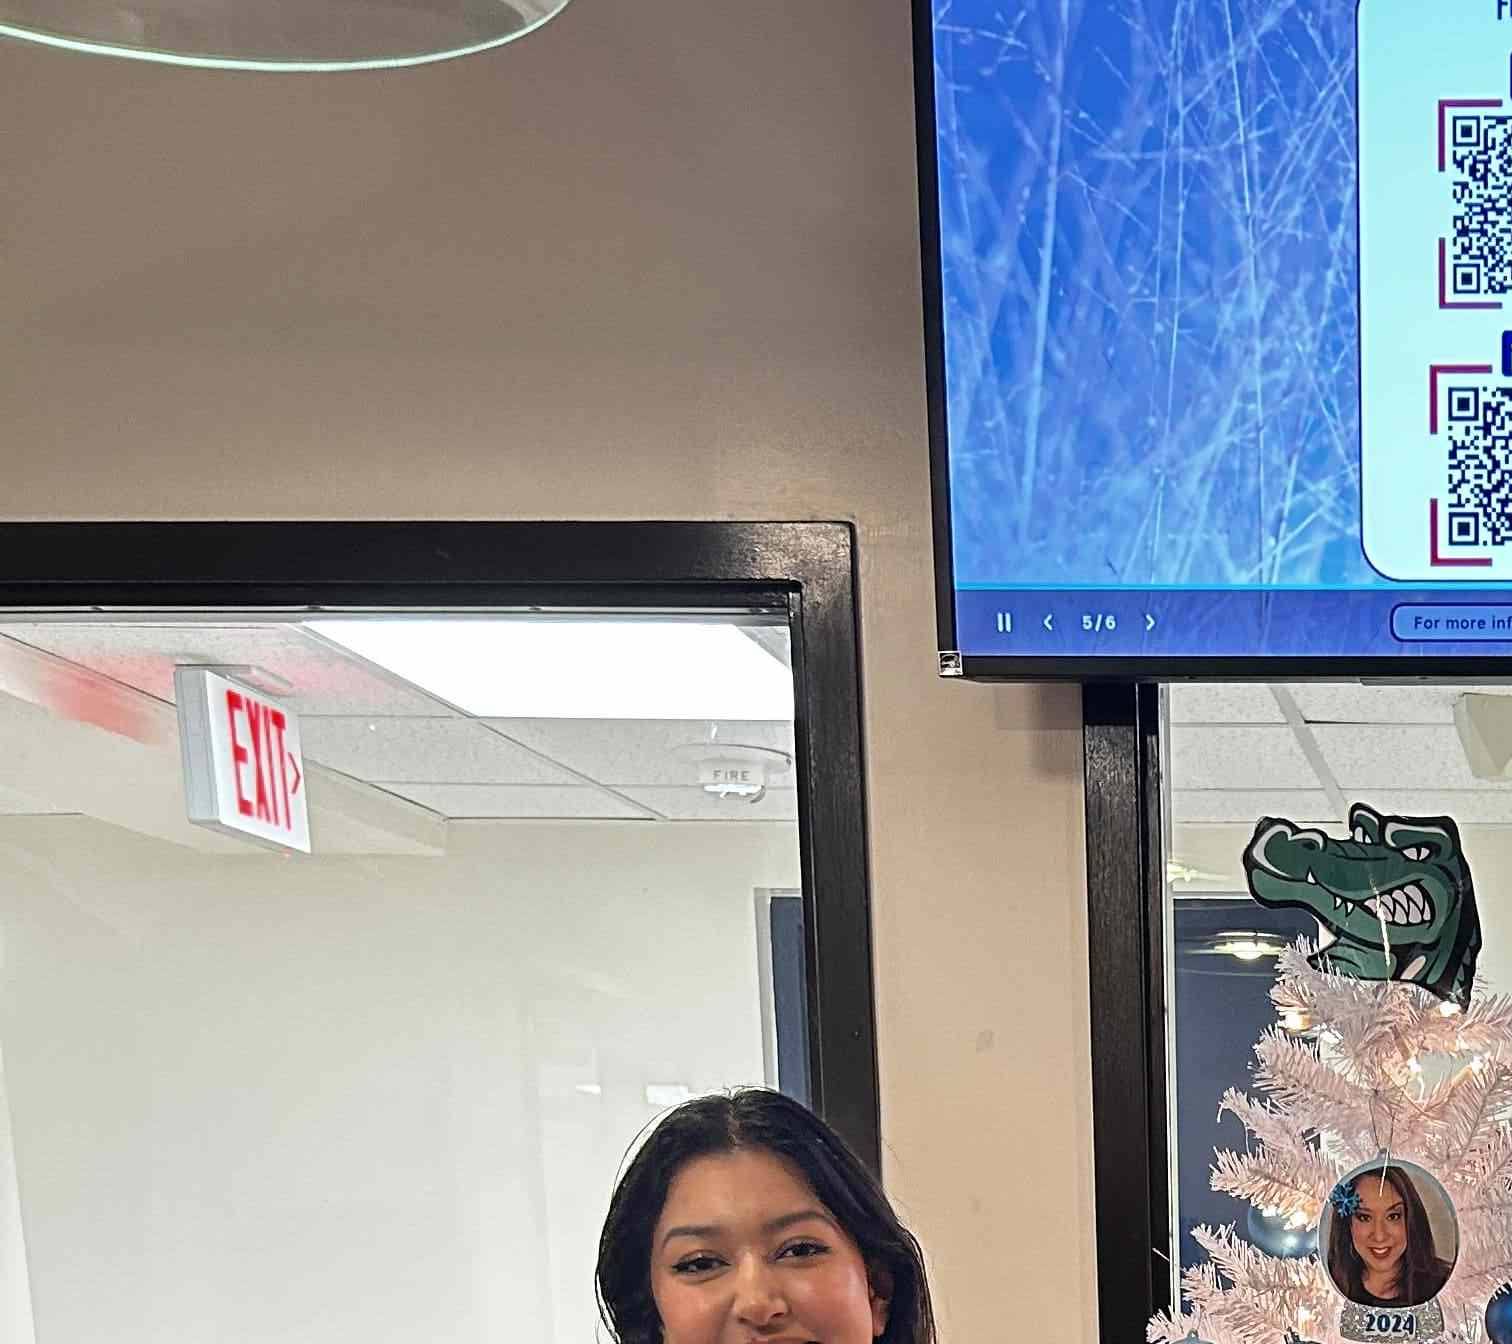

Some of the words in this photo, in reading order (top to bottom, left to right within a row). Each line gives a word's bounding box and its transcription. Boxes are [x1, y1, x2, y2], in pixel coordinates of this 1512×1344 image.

[1082, 614, 1116, 631] 5/6
[1413, 616, 1440, 630] For
[1446, 619, 1487, 631] more
[226, 689, 292, 831] EXIT
[1365, 1313, 1414, 1335] 2024
